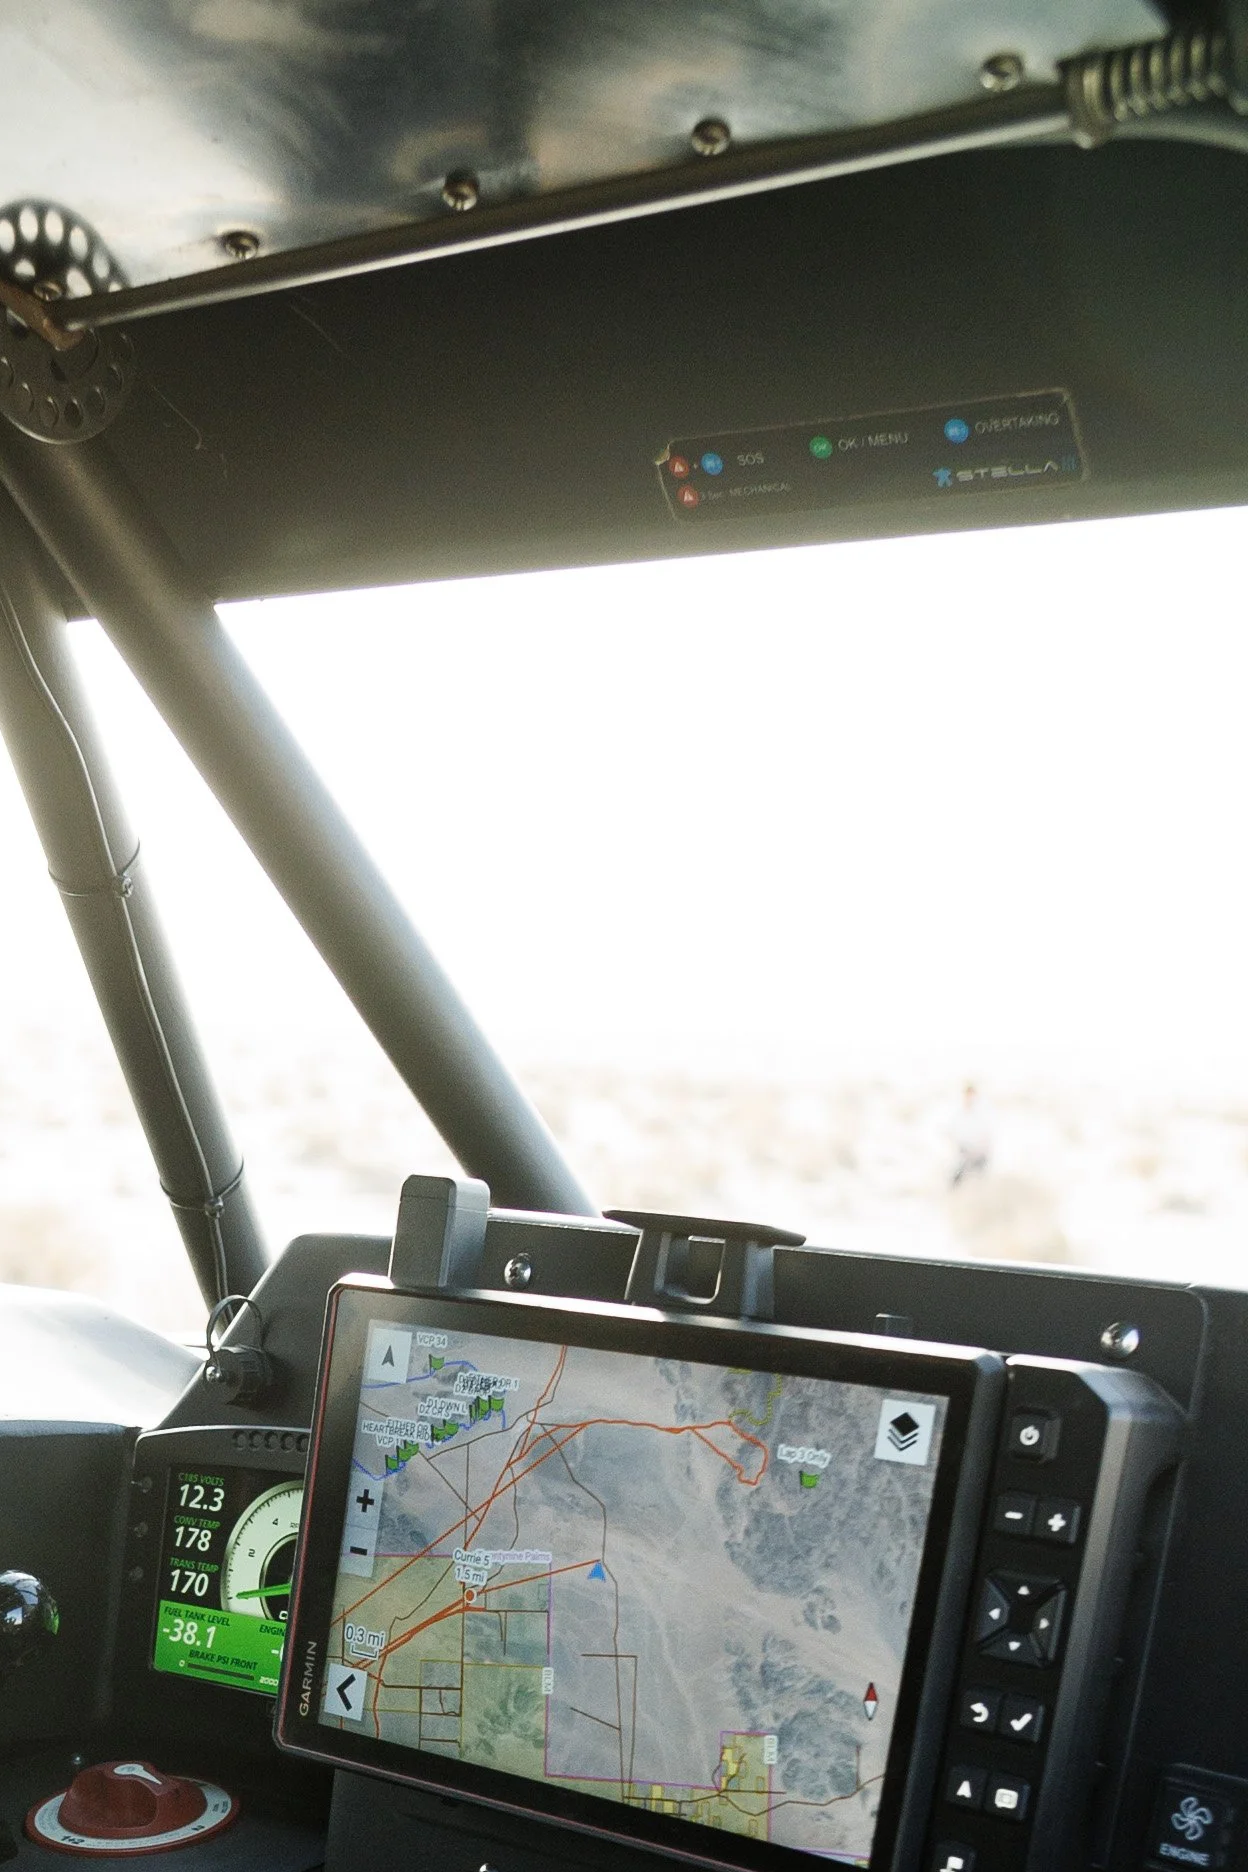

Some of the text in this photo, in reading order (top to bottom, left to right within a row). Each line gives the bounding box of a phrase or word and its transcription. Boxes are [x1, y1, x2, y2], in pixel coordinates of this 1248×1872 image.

[975, 412, 1059, 434] OVERTAKING
[868, 432, 909, 446] MENU
[737, 451, 764, 466] SOS
[956, 461, 1058, 482] STELLA
[418, 1334, 435, 1345] VCP
[377, 1435, 394, 1446] VCP
[200, 1475, 224, 1487] VOLTS
[179, 1483, 225, 1512] 12.3
[174, 1515, 221, 1530] CONV TEMP
[272, 1518, 278, 1526] 4
[175, 1525, 212, 1552] 178
[248, 1548, 256, 1558] 2
[454, 1550, 490, 1566] Currie 5
[170, 1557, 219, 1574] TRANS TEMP
[170, 1569, 209, 1597] 170
[456, 1568, 485, 1583] 1.5 mi
[163, 1606, 231, 1627] FUEL TANK LEVEL
[163, 1618, 216, 1649] -38.1
[259, 1624, 285, 1637] ENGIN
[346, 1625, 385, 1647] 0.3 mi
[189, 1649, 259, 1671] BRAKE PSI FRONT
[299, 1641, 317, 1716] GARMIN
[1159, 1842, 1210, 1867] ENGINE
